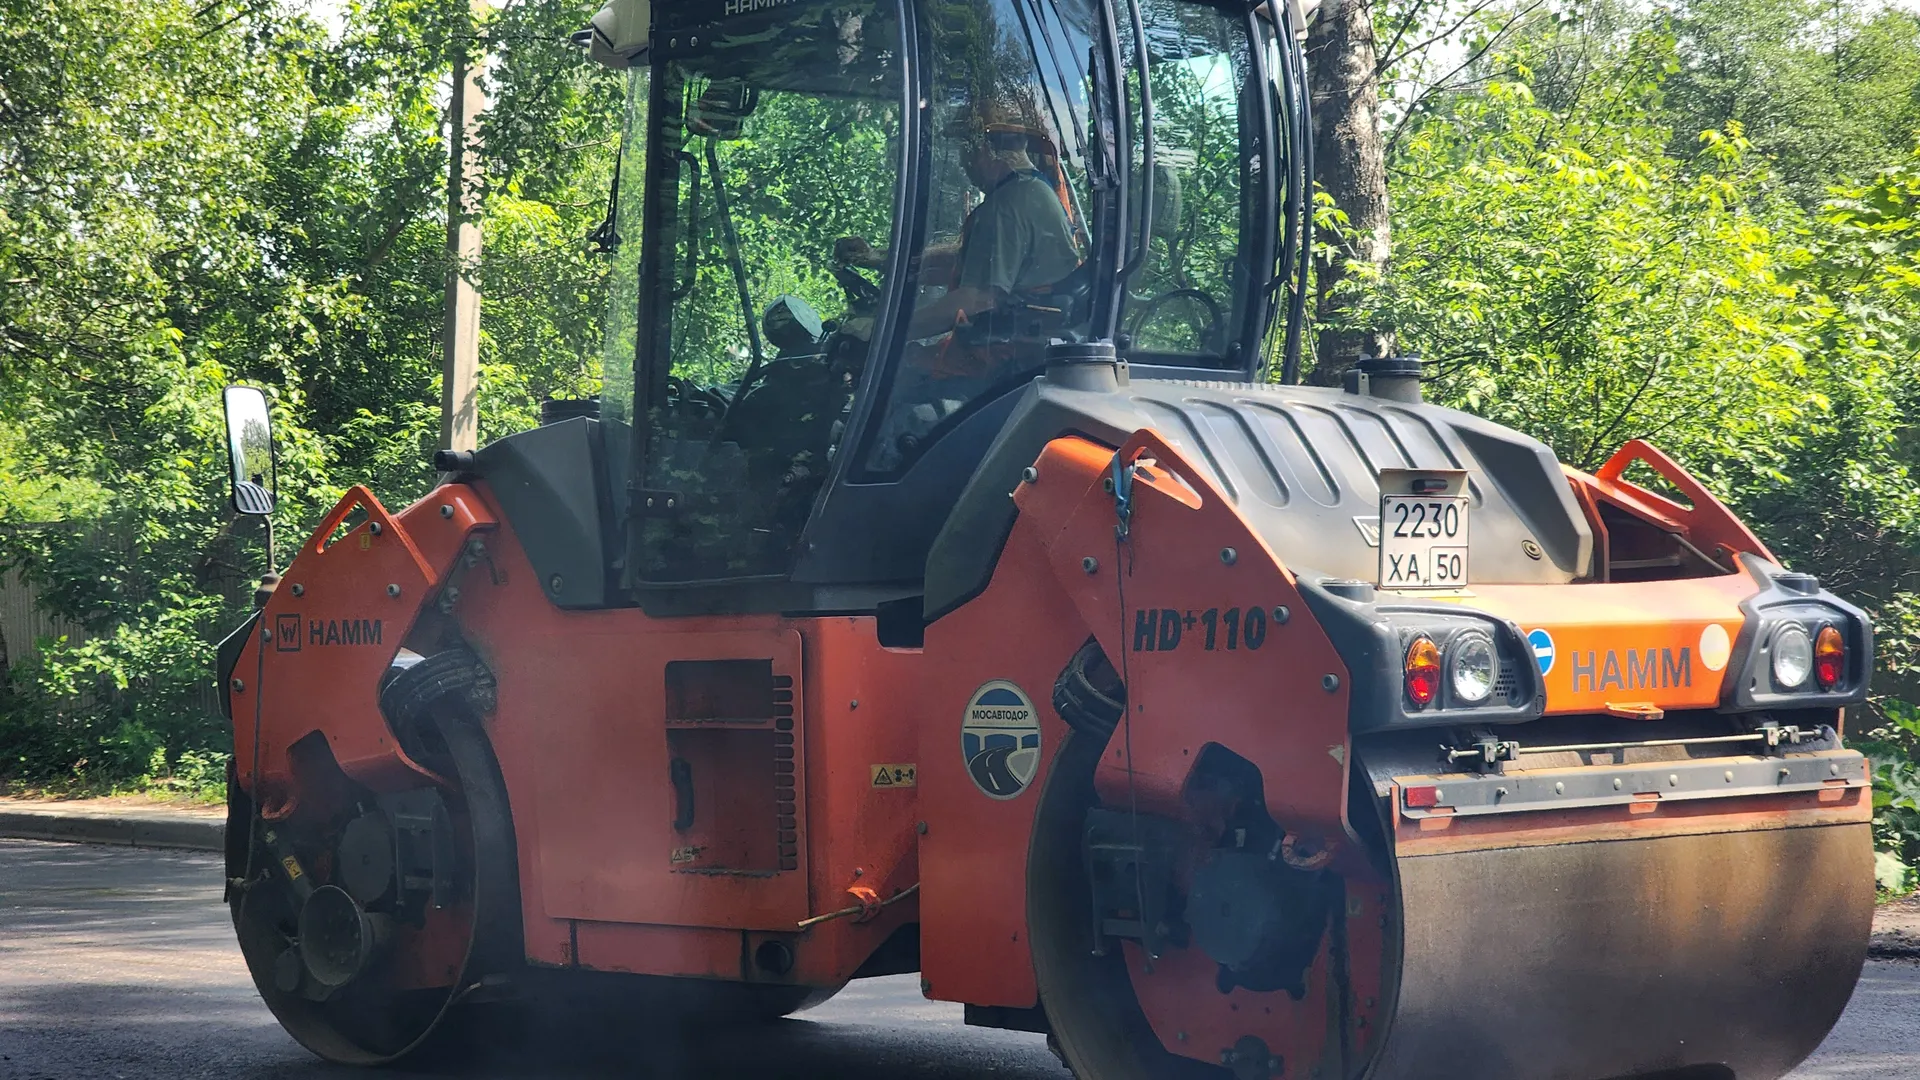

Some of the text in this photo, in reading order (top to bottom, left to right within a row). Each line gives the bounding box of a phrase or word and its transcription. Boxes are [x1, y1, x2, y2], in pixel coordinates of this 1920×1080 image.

[725, 0, 787, 15] HAM
[1393, 503, 1459, 538] 2230
[1437, 554, 1461, 580] 50
[309, 619, 382, 645] HAMM
[1572, 647, 1691, 693] HAMM
[972, 710, 1029, 721] МОСАВТОДОР
